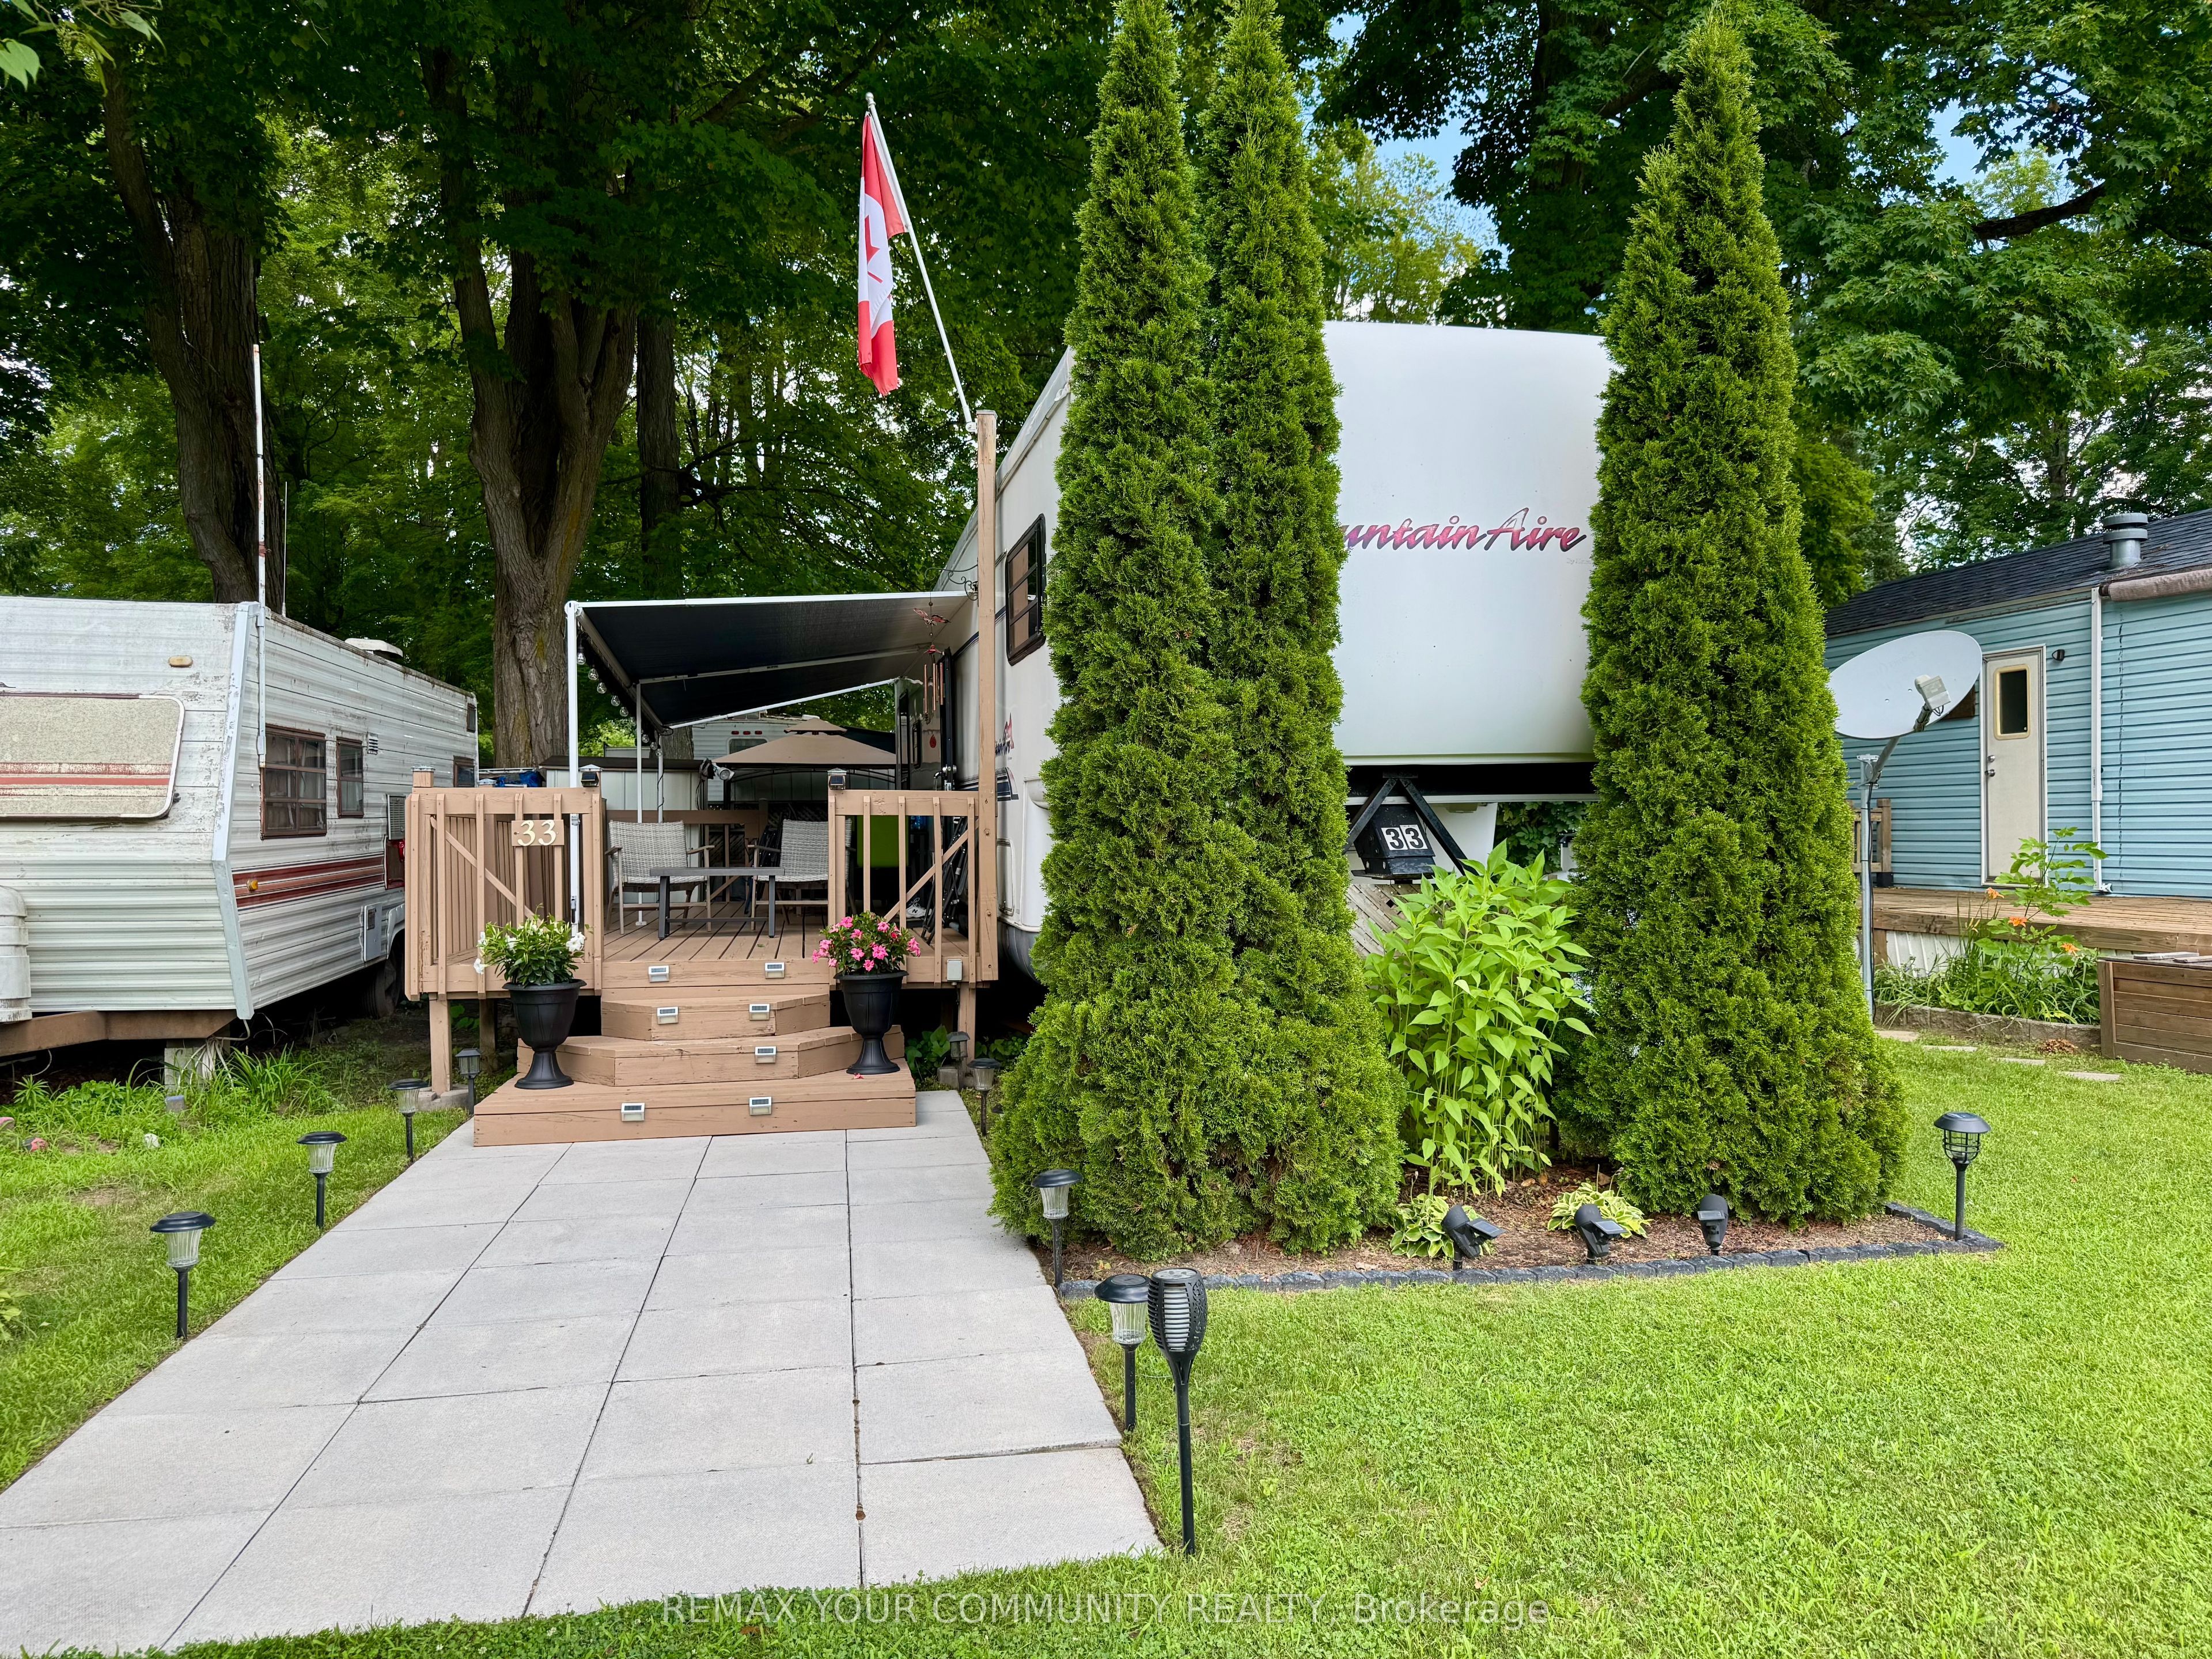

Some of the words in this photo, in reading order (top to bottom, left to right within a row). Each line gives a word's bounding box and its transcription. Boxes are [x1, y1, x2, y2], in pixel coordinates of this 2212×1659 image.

[1484, 507, 1586, 552] Aire
[517, 820, 557, 846] 33
[1385, 828, 1423, 849] 33
